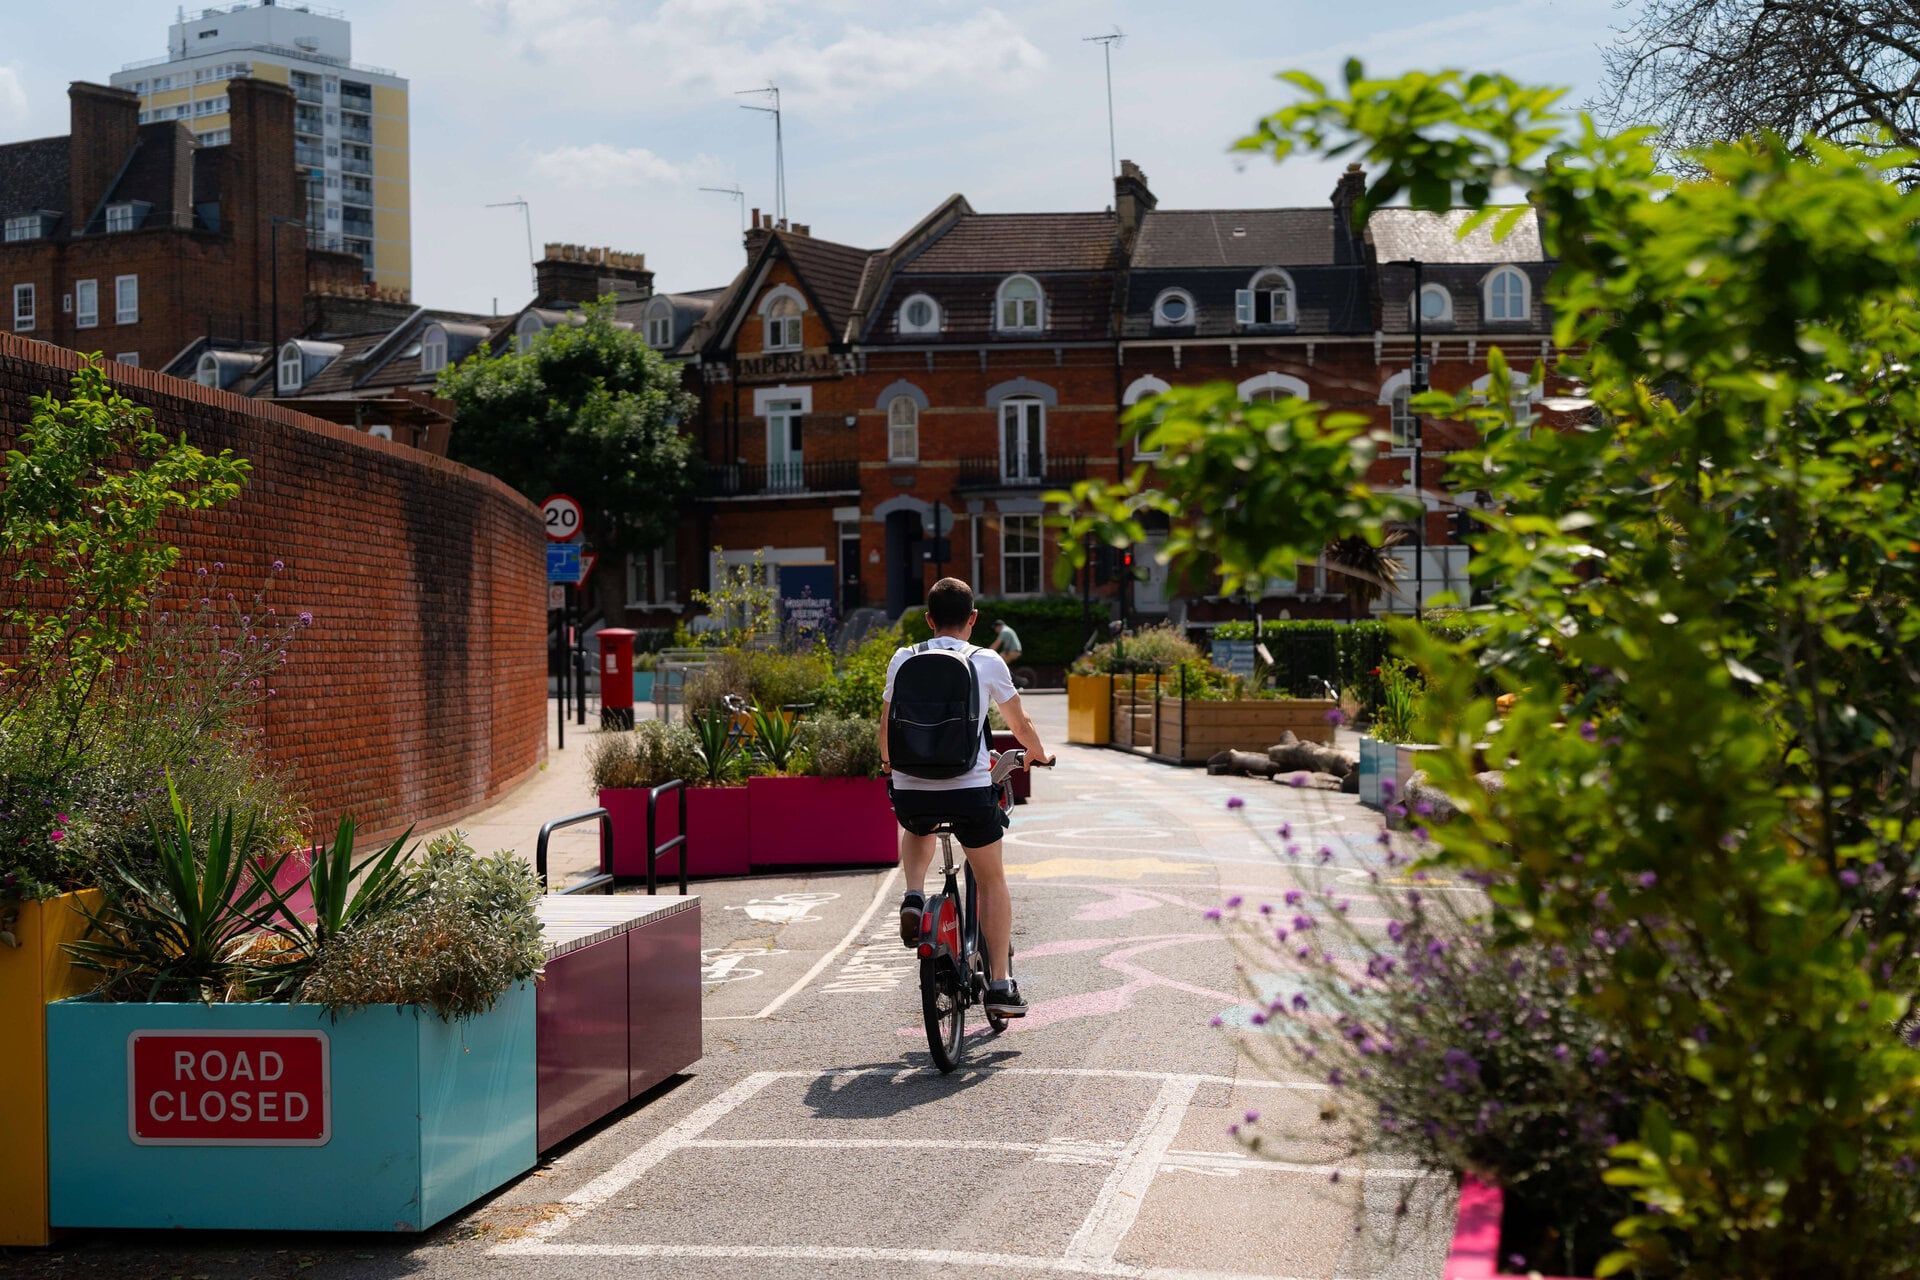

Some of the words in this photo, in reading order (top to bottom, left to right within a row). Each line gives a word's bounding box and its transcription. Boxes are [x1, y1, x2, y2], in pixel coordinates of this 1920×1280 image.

[736, 353, 833, 376] IMPERIAL
[546, 508, 576, 527] 20
[174, 1050, 284, 1082] ROAD
[149, 1090, 309, 1122] CLOSED
